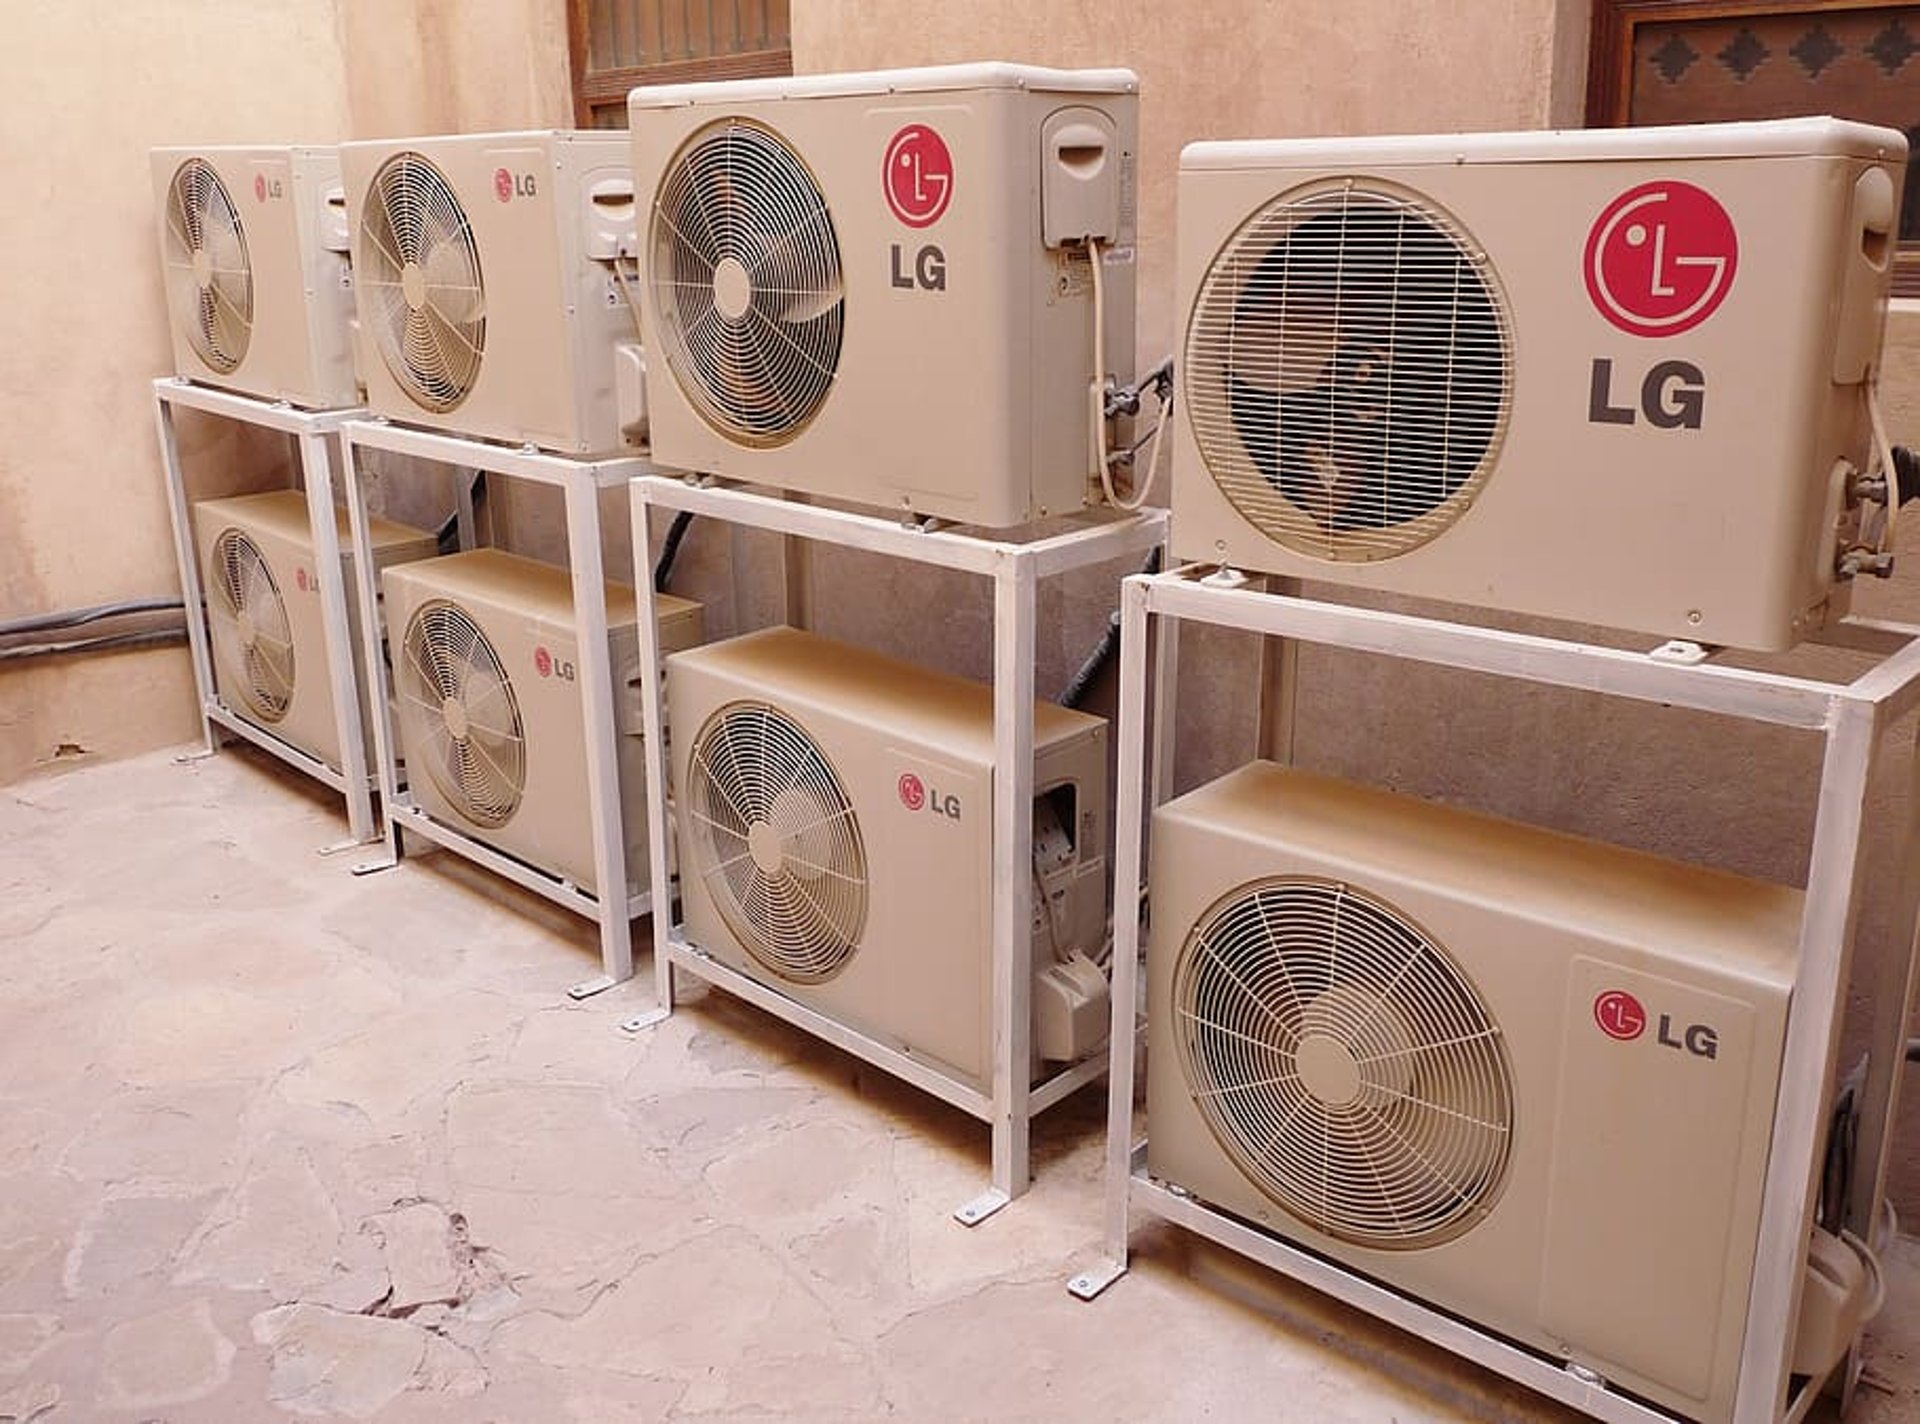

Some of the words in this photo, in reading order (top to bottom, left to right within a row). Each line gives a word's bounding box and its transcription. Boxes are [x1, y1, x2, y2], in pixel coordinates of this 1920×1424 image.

[267, 179, 282, 199] LG
[515, 174, 537, 197] LG
[891, 244, 947, 291] LG
[1588, 358, 1706, 430] LG
[554, 658, 575, 681] LG
[931, 789, 961, 821] LG
[1658, 1014, 1719, 1060] LG
